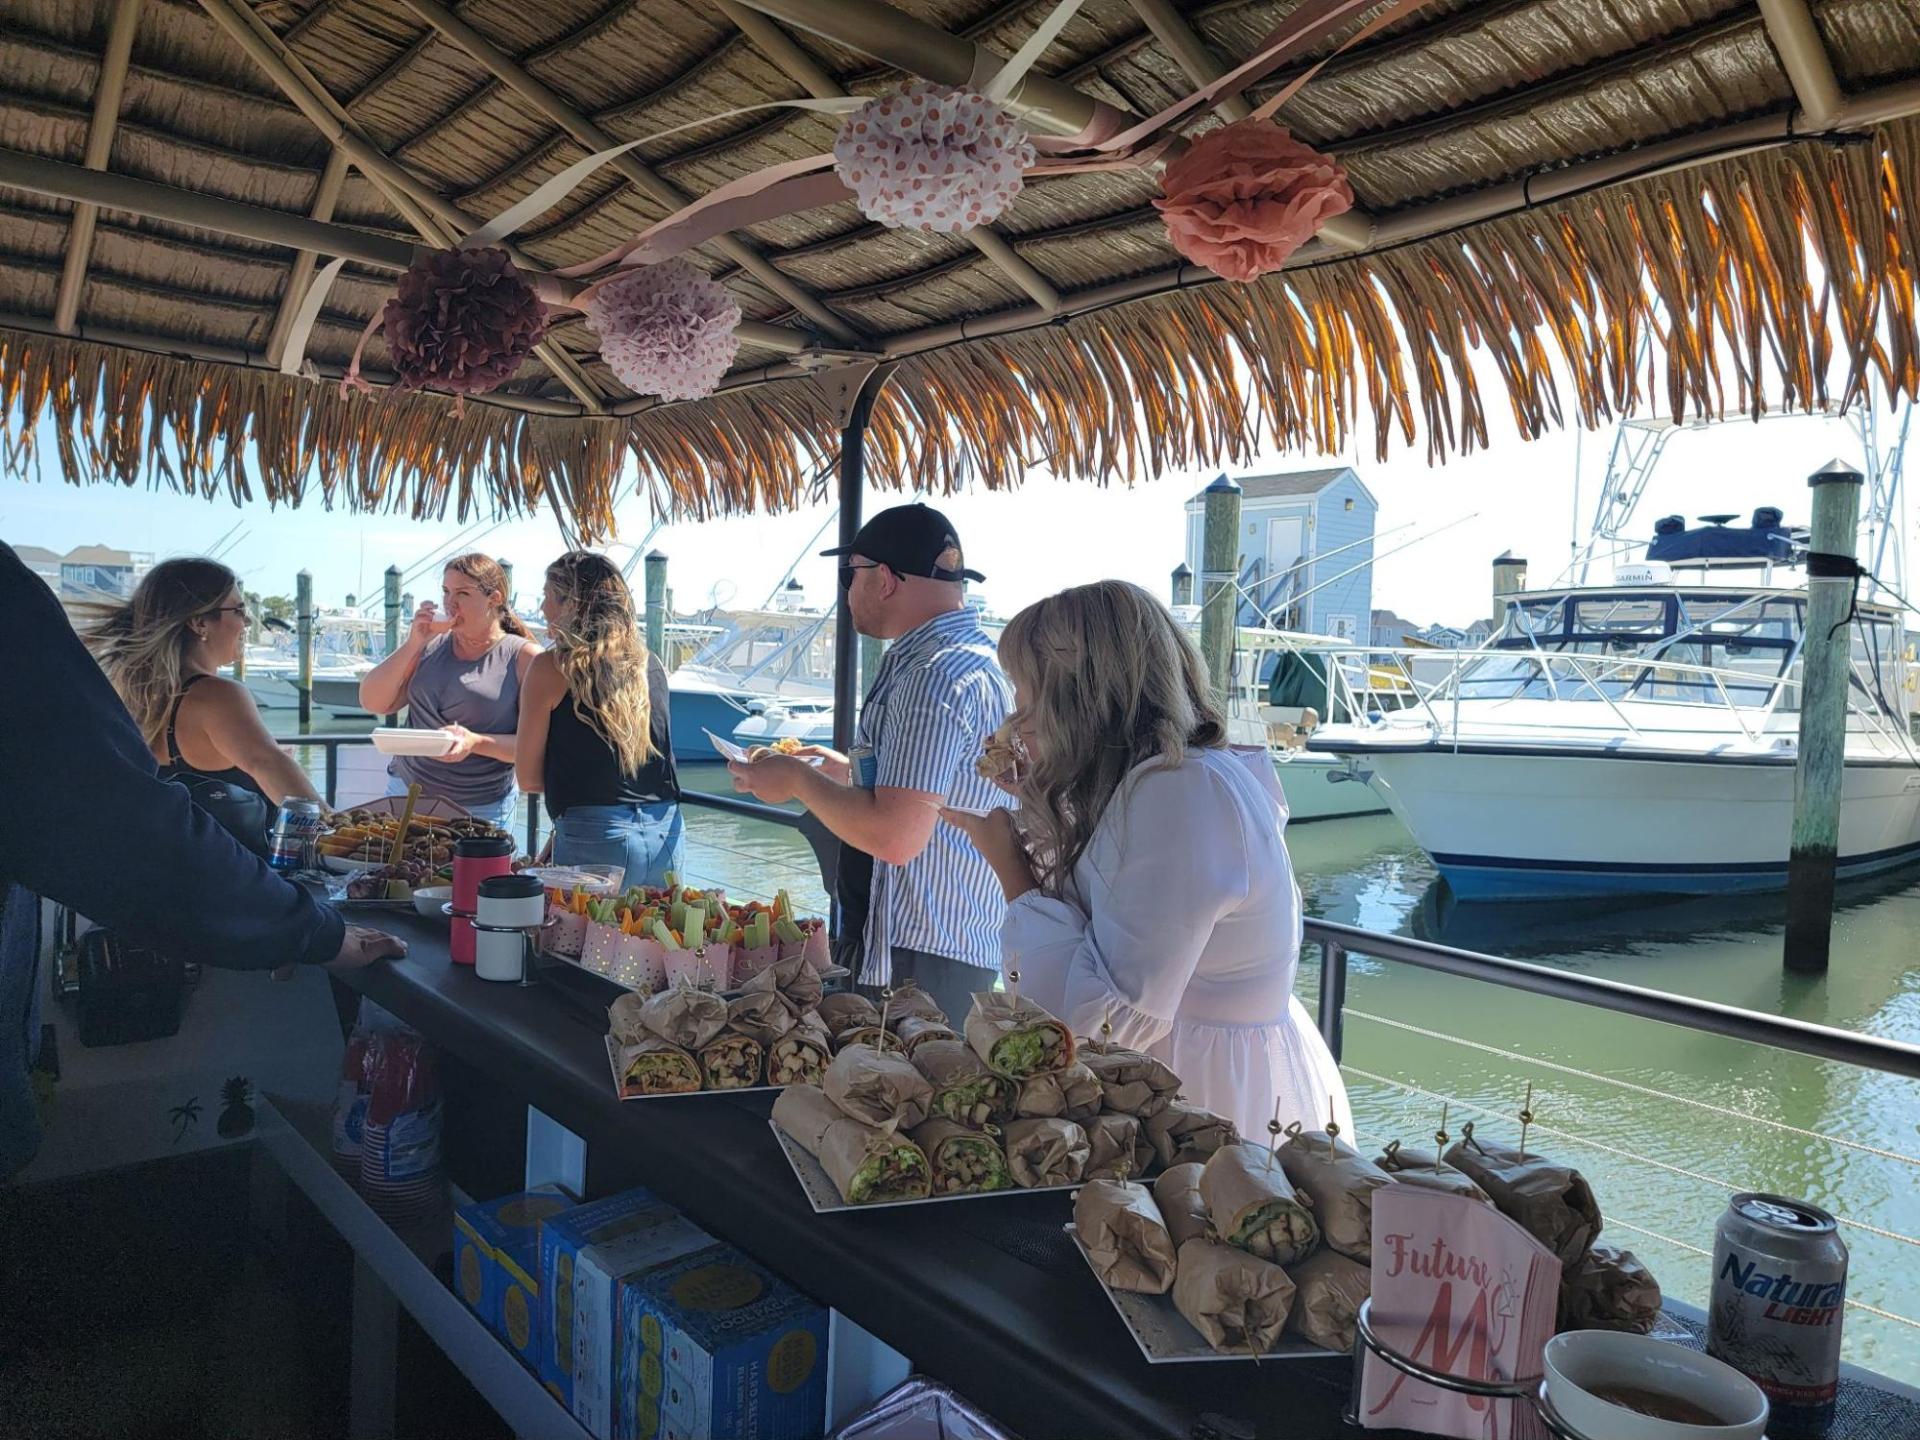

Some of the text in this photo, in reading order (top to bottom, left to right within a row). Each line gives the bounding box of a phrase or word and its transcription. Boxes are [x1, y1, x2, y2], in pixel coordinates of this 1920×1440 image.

[1384, 1233, 1491, 1289] Future
[1720, 1252, 1846, 1308] Natural
[1763, 1303, 1841, 1327] LIGHT
[748, 1398, 759, 1440] SELTZE
